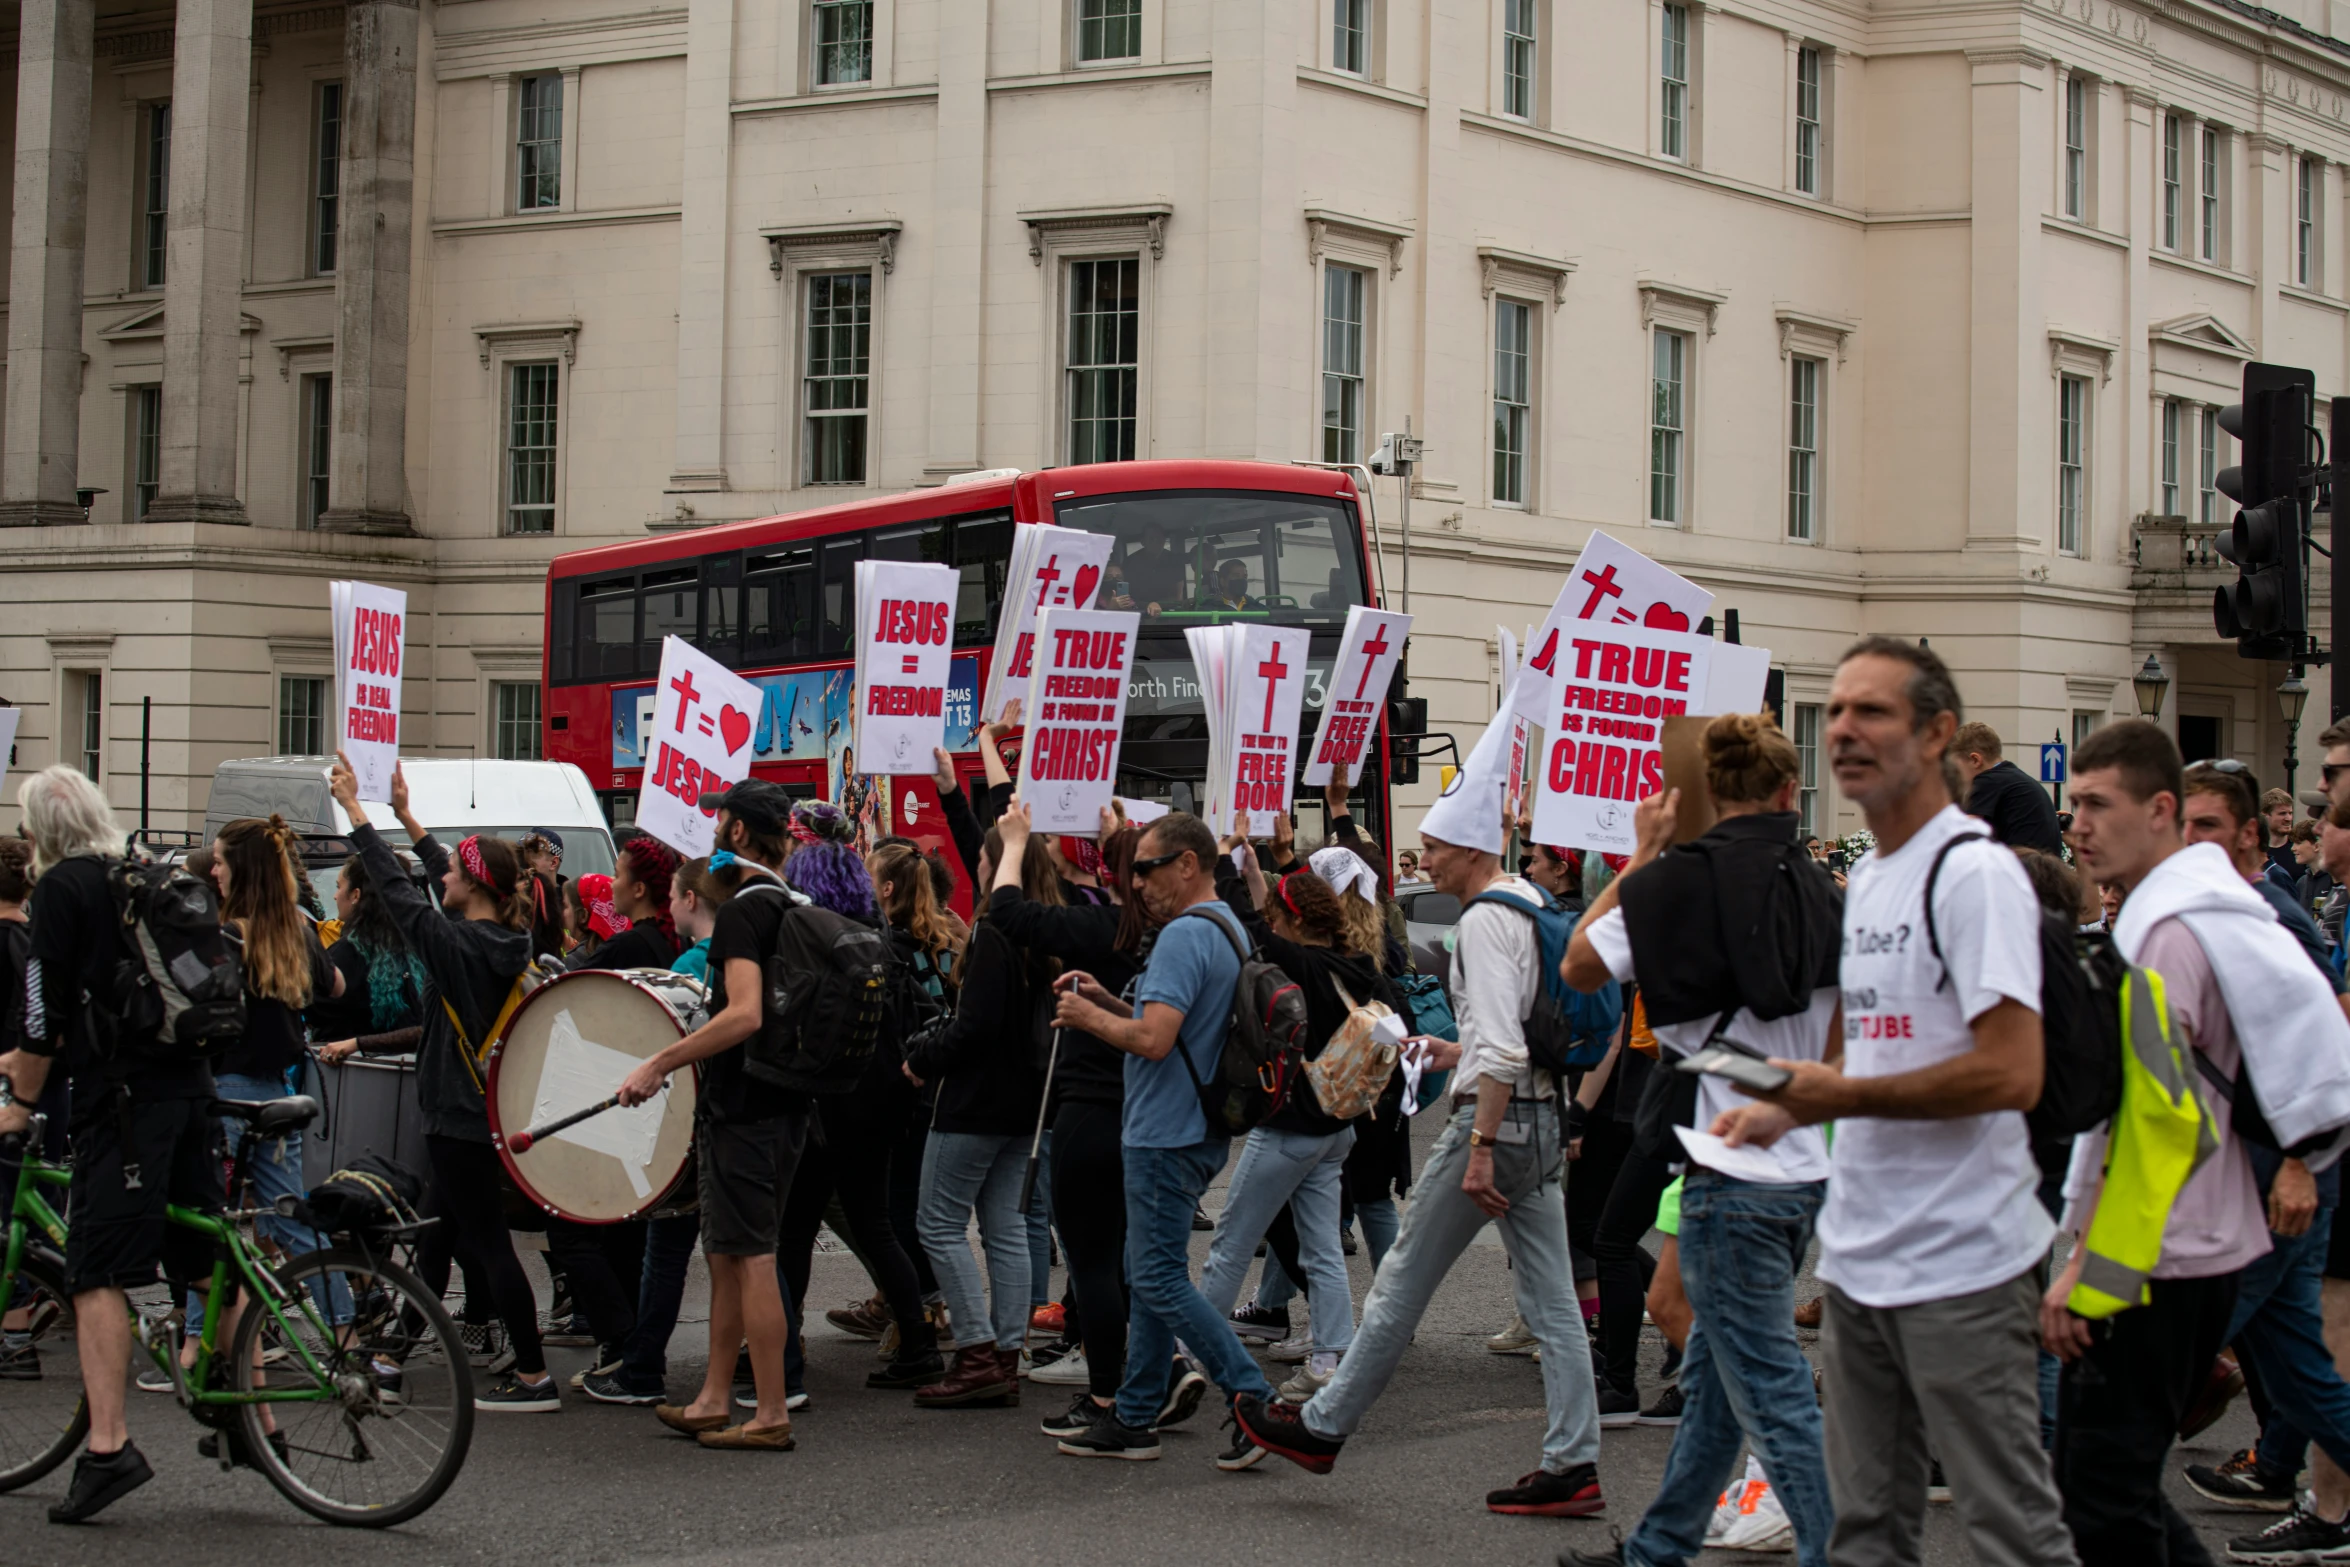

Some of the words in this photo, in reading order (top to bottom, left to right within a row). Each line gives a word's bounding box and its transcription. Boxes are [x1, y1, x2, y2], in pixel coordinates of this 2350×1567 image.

[875, 599, 949, 646] JESUS
[350, 607, 401, 677] JESUS
[1053, 629, 1127, 671] TRUE
[1571, 638, 1692, 693] TRUE
[355, 683, 367, 706] IS
[368, 685, 391, 709] REAL
[867, 685, 944, 717] FREEDOM
[946, 688, 972, 702] EMAS
[1044, 675, 1121, 699] FREEDOM
[1127, 677, 1167, 698] orth
[1304, 669, 1327, 708] 3
[1563, 684, 1688, 720] FREEDOM
[347, 707, 397, 744] FREEDOM
[956, 705, 972, 727] 13
[1041, 703, 1056, 720] IS
[1058, 703, 1100, 722] FOUND
[1101, 704, 1116, 722] IN
[1241, 734, 1256, 748] THE
[1258, 735, 1276, 749] WAY
[1277, 736, 1288, 750] TO
[1325, 715, 1371, 741] FREE
[1561, 713, 1583, 732] IS
[1586, 717, 1656, 743] FOUND
[1030, 727, 1118, 782] CHRIST
[1237, 752, 1287, 782] FREE
[1317, 739, 1363, 765] DOM
[1548, 737, 1664, 803] CHRIS
[1234, 782, 1284, 812] DOM
